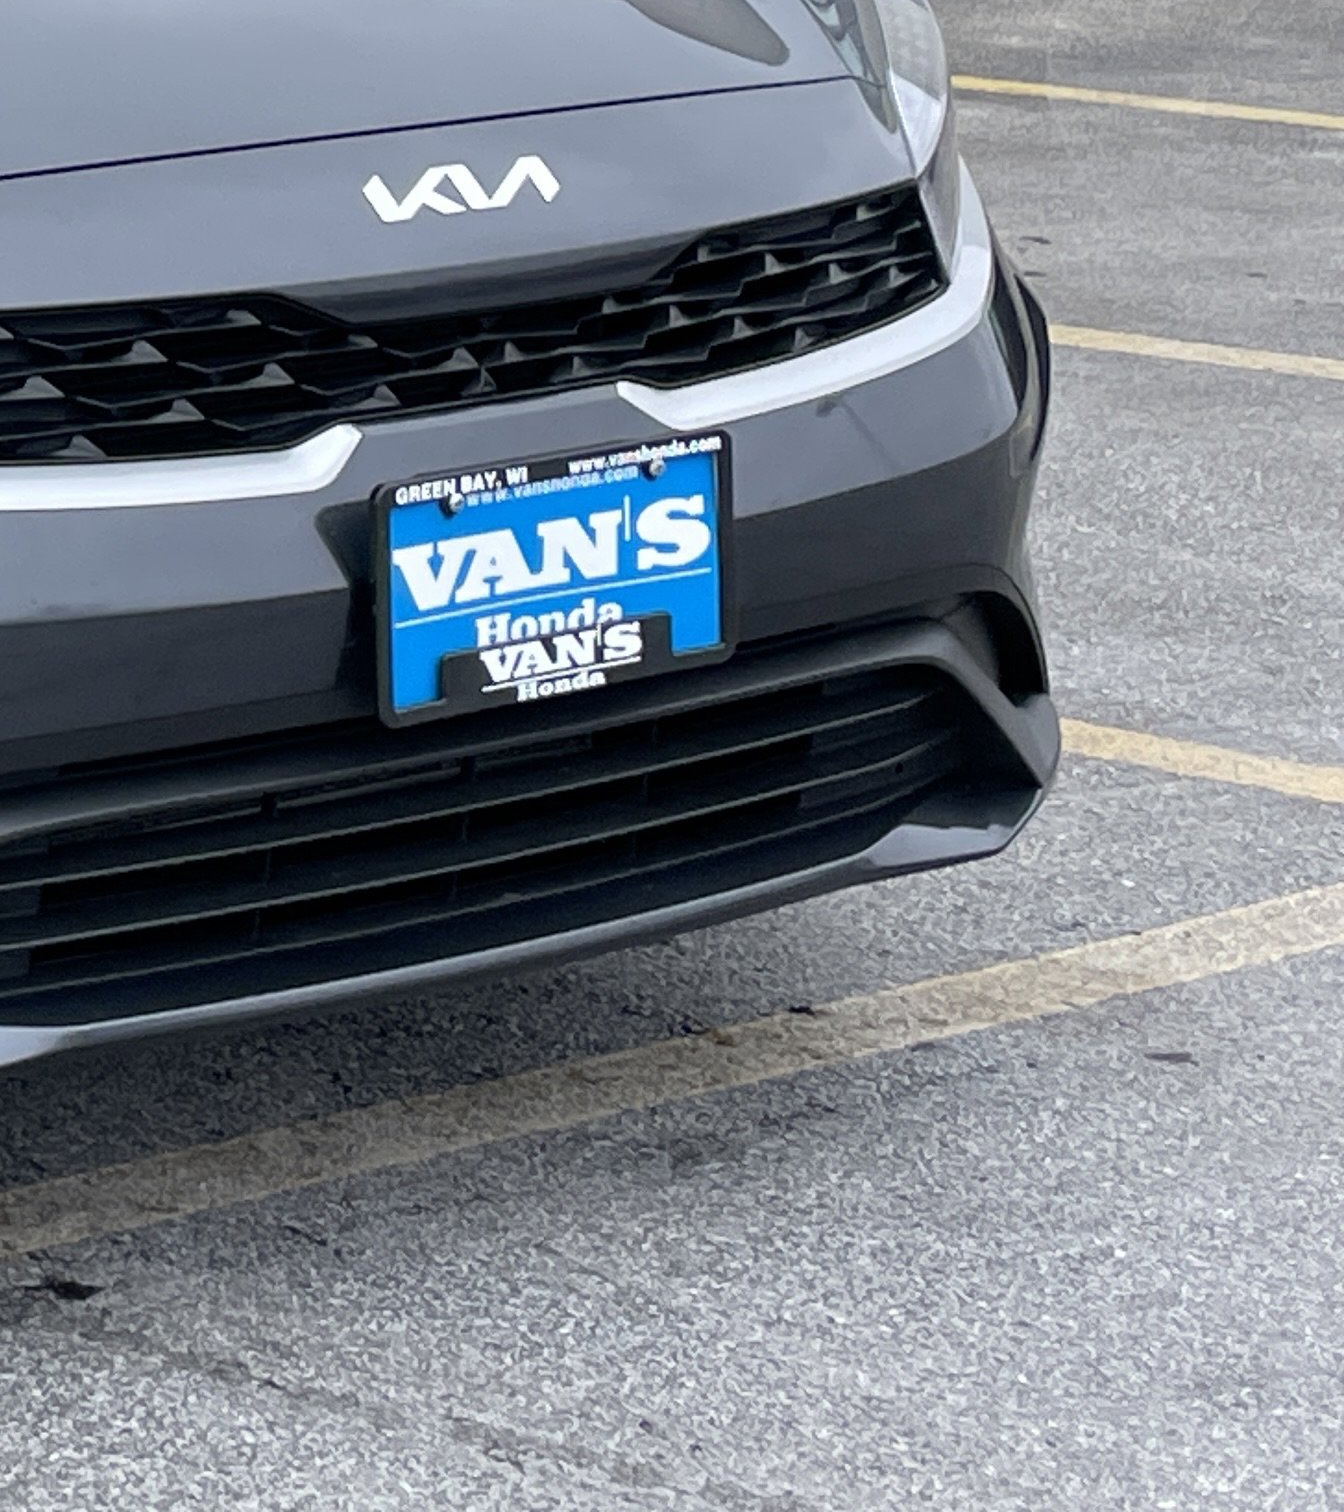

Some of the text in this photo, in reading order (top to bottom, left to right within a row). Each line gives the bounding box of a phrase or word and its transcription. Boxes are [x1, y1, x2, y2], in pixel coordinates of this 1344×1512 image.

[361, 155, 561, 224] KIA
[395, 436, 722, 506] GREEN BAY, WI www.vanshonda.com
[392, 494, 712, 613] VAN'S
[475, 597, 623, 647] Honda
[480, 621, 643, 683] VAN'S
[517, 670, 607, 702] Honda
